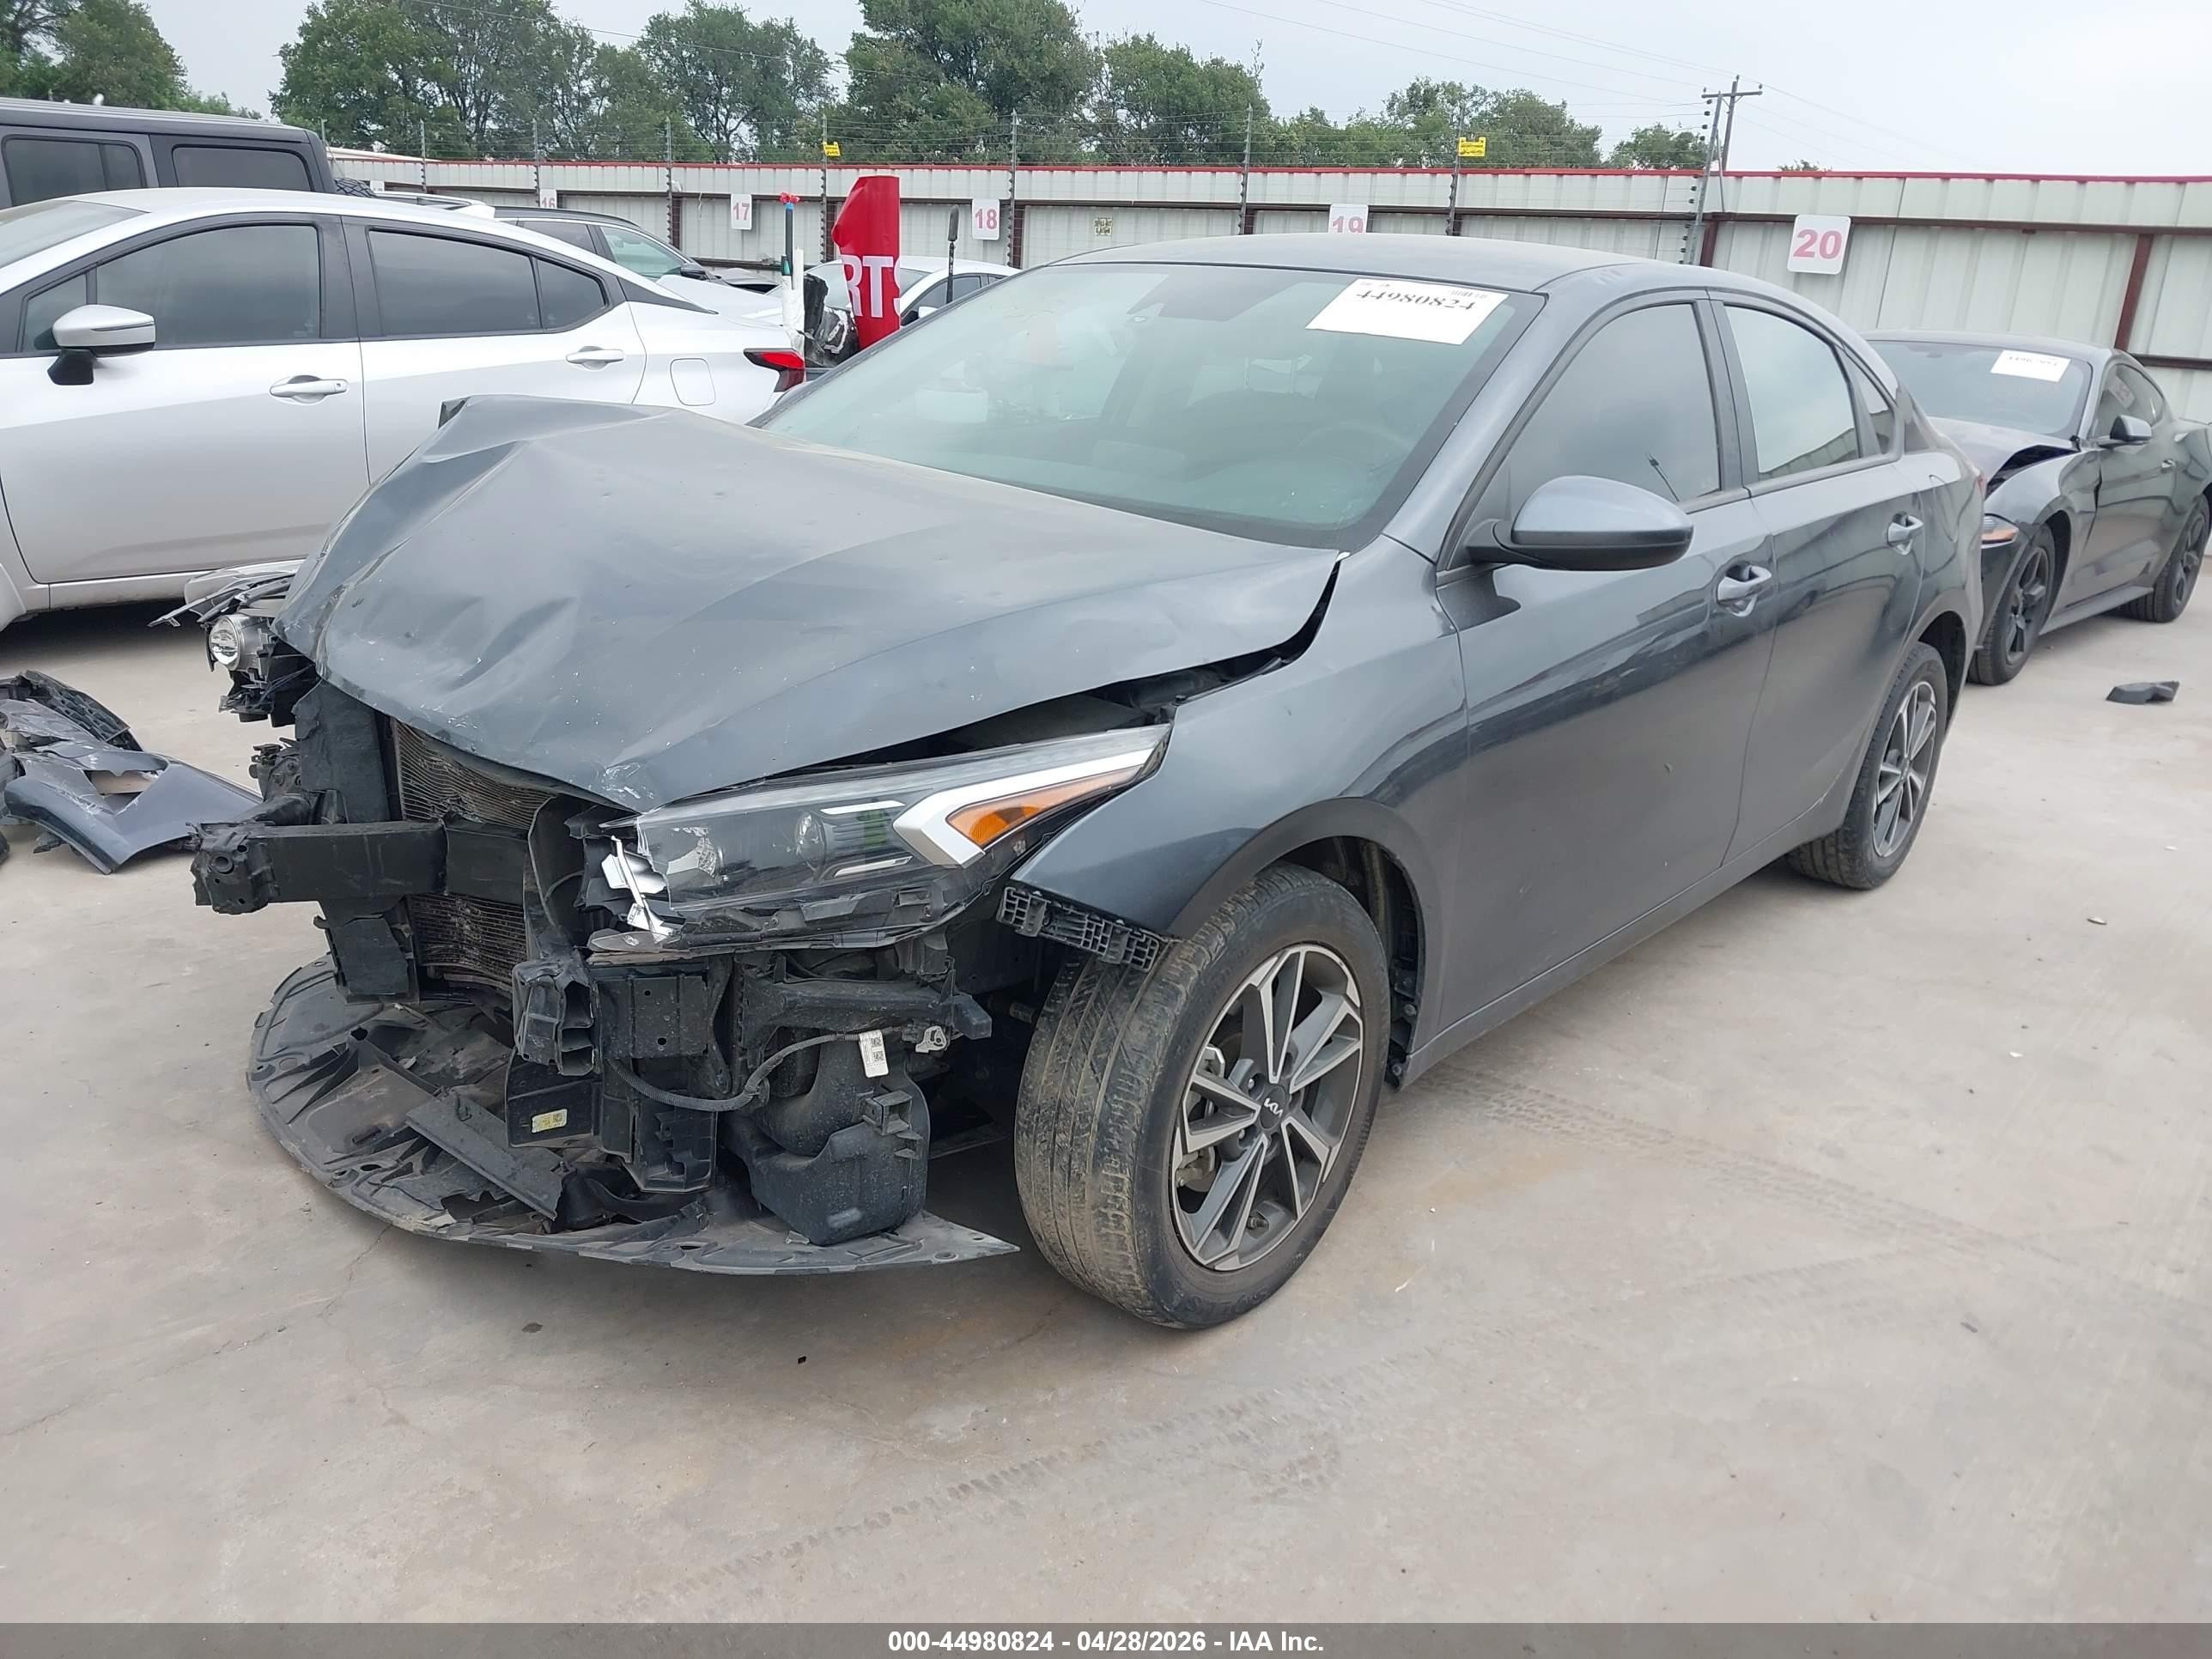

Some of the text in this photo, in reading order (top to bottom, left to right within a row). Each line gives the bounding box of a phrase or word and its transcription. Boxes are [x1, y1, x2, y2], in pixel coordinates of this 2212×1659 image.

[732, 203, 750, 221] 17
[975, 209, 998, 229] 18
[1332, 215, 1364, 233] 19
[1792, 228, 1843, 259] 20
[1356, 289, 1477, 311] 44980824
